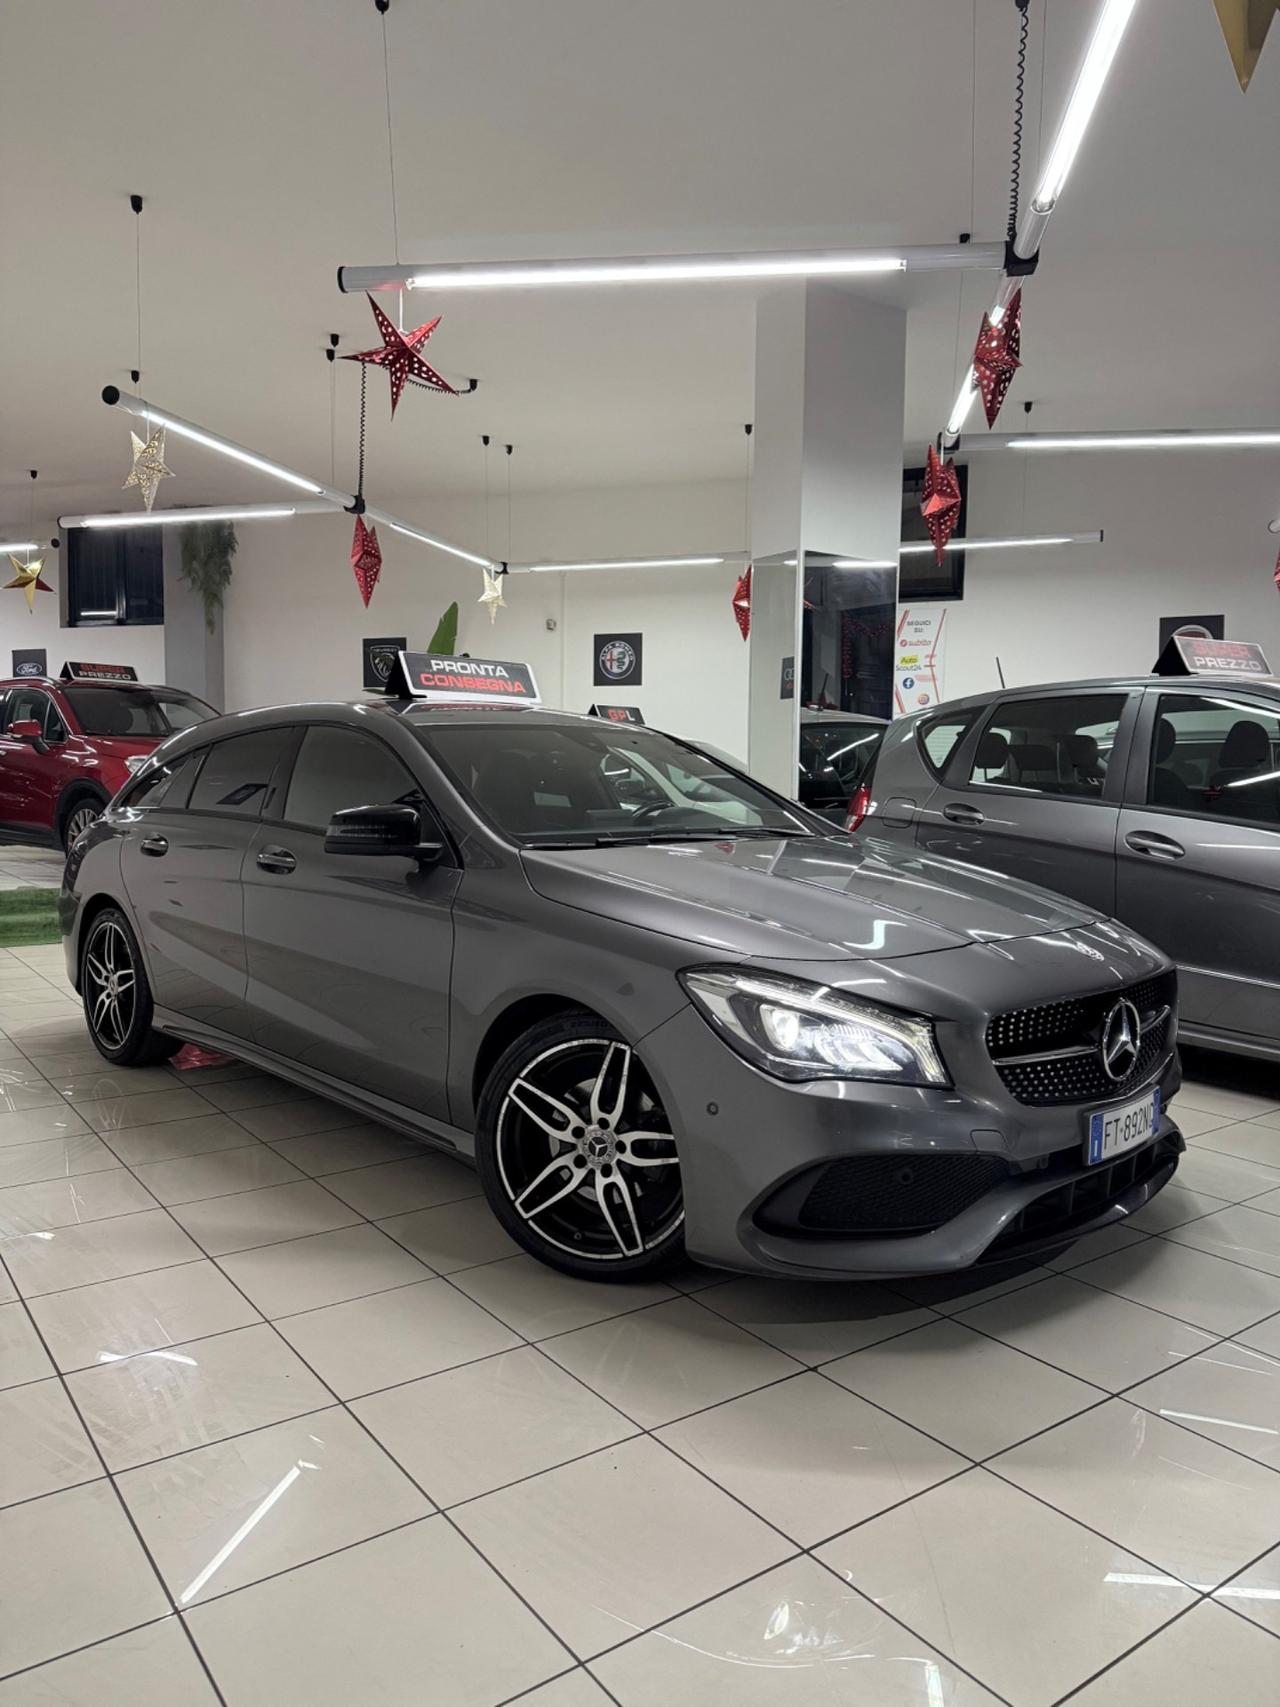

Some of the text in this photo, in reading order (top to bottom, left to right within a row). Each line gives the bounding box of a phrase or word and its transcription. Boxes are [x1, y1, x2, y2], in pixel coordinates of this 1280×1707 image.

[1193, 642, 1249, 658] SUPER
[20, 664, 37, 674] Ford
[430, 660, 509, 678] PRONTA
[1193, 656, 1262, 671] PREZZO
[79, 671, 131, 680] PREZZO
[420, 674, 526, 693] CONSEGNA
[607, 709, 635, 722] GPL
